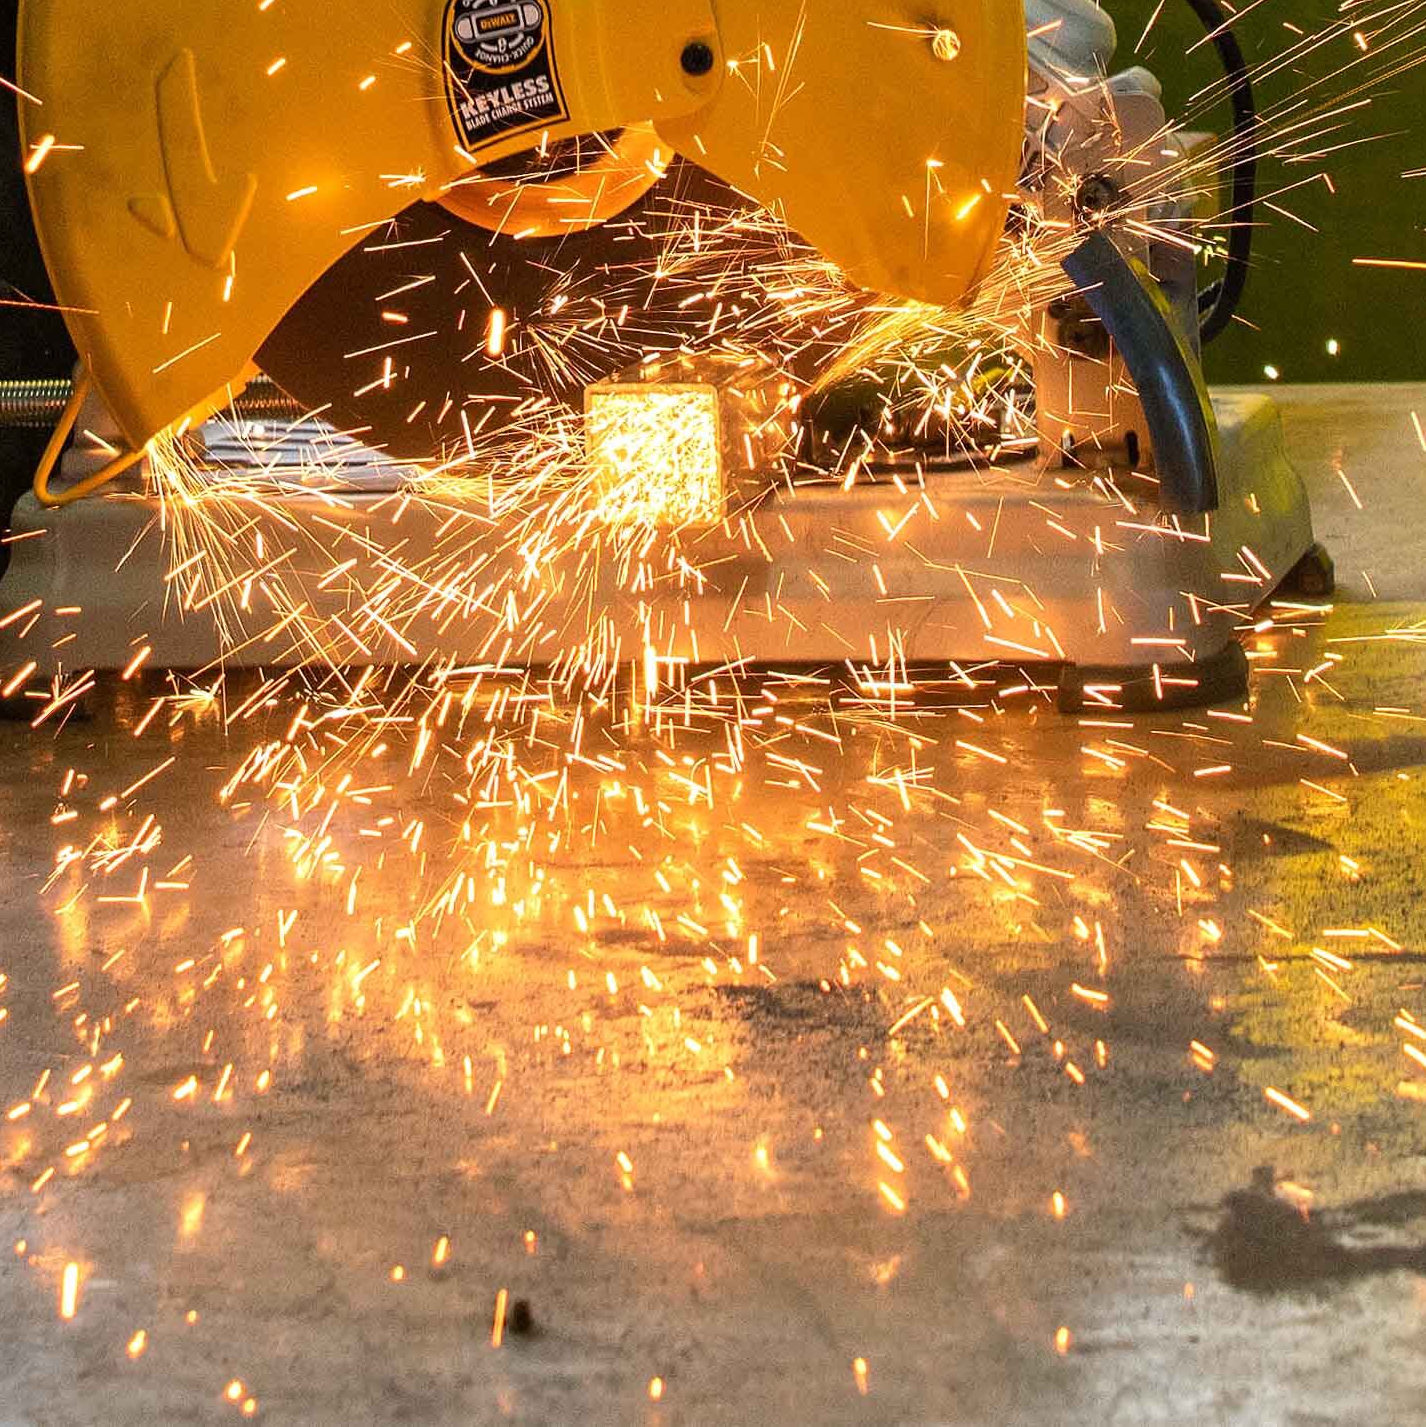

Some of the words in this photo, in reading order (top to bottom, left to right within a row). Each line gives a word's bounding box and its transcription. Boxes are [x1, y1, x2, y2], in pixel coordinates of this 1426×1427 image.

[460, 75, 549, 119] KEYLESS
[465, 112, 491, 131] BLADE
[491, 100, 523, 121] CHANGE
[523, 92, 554, 111] SYSTEM
